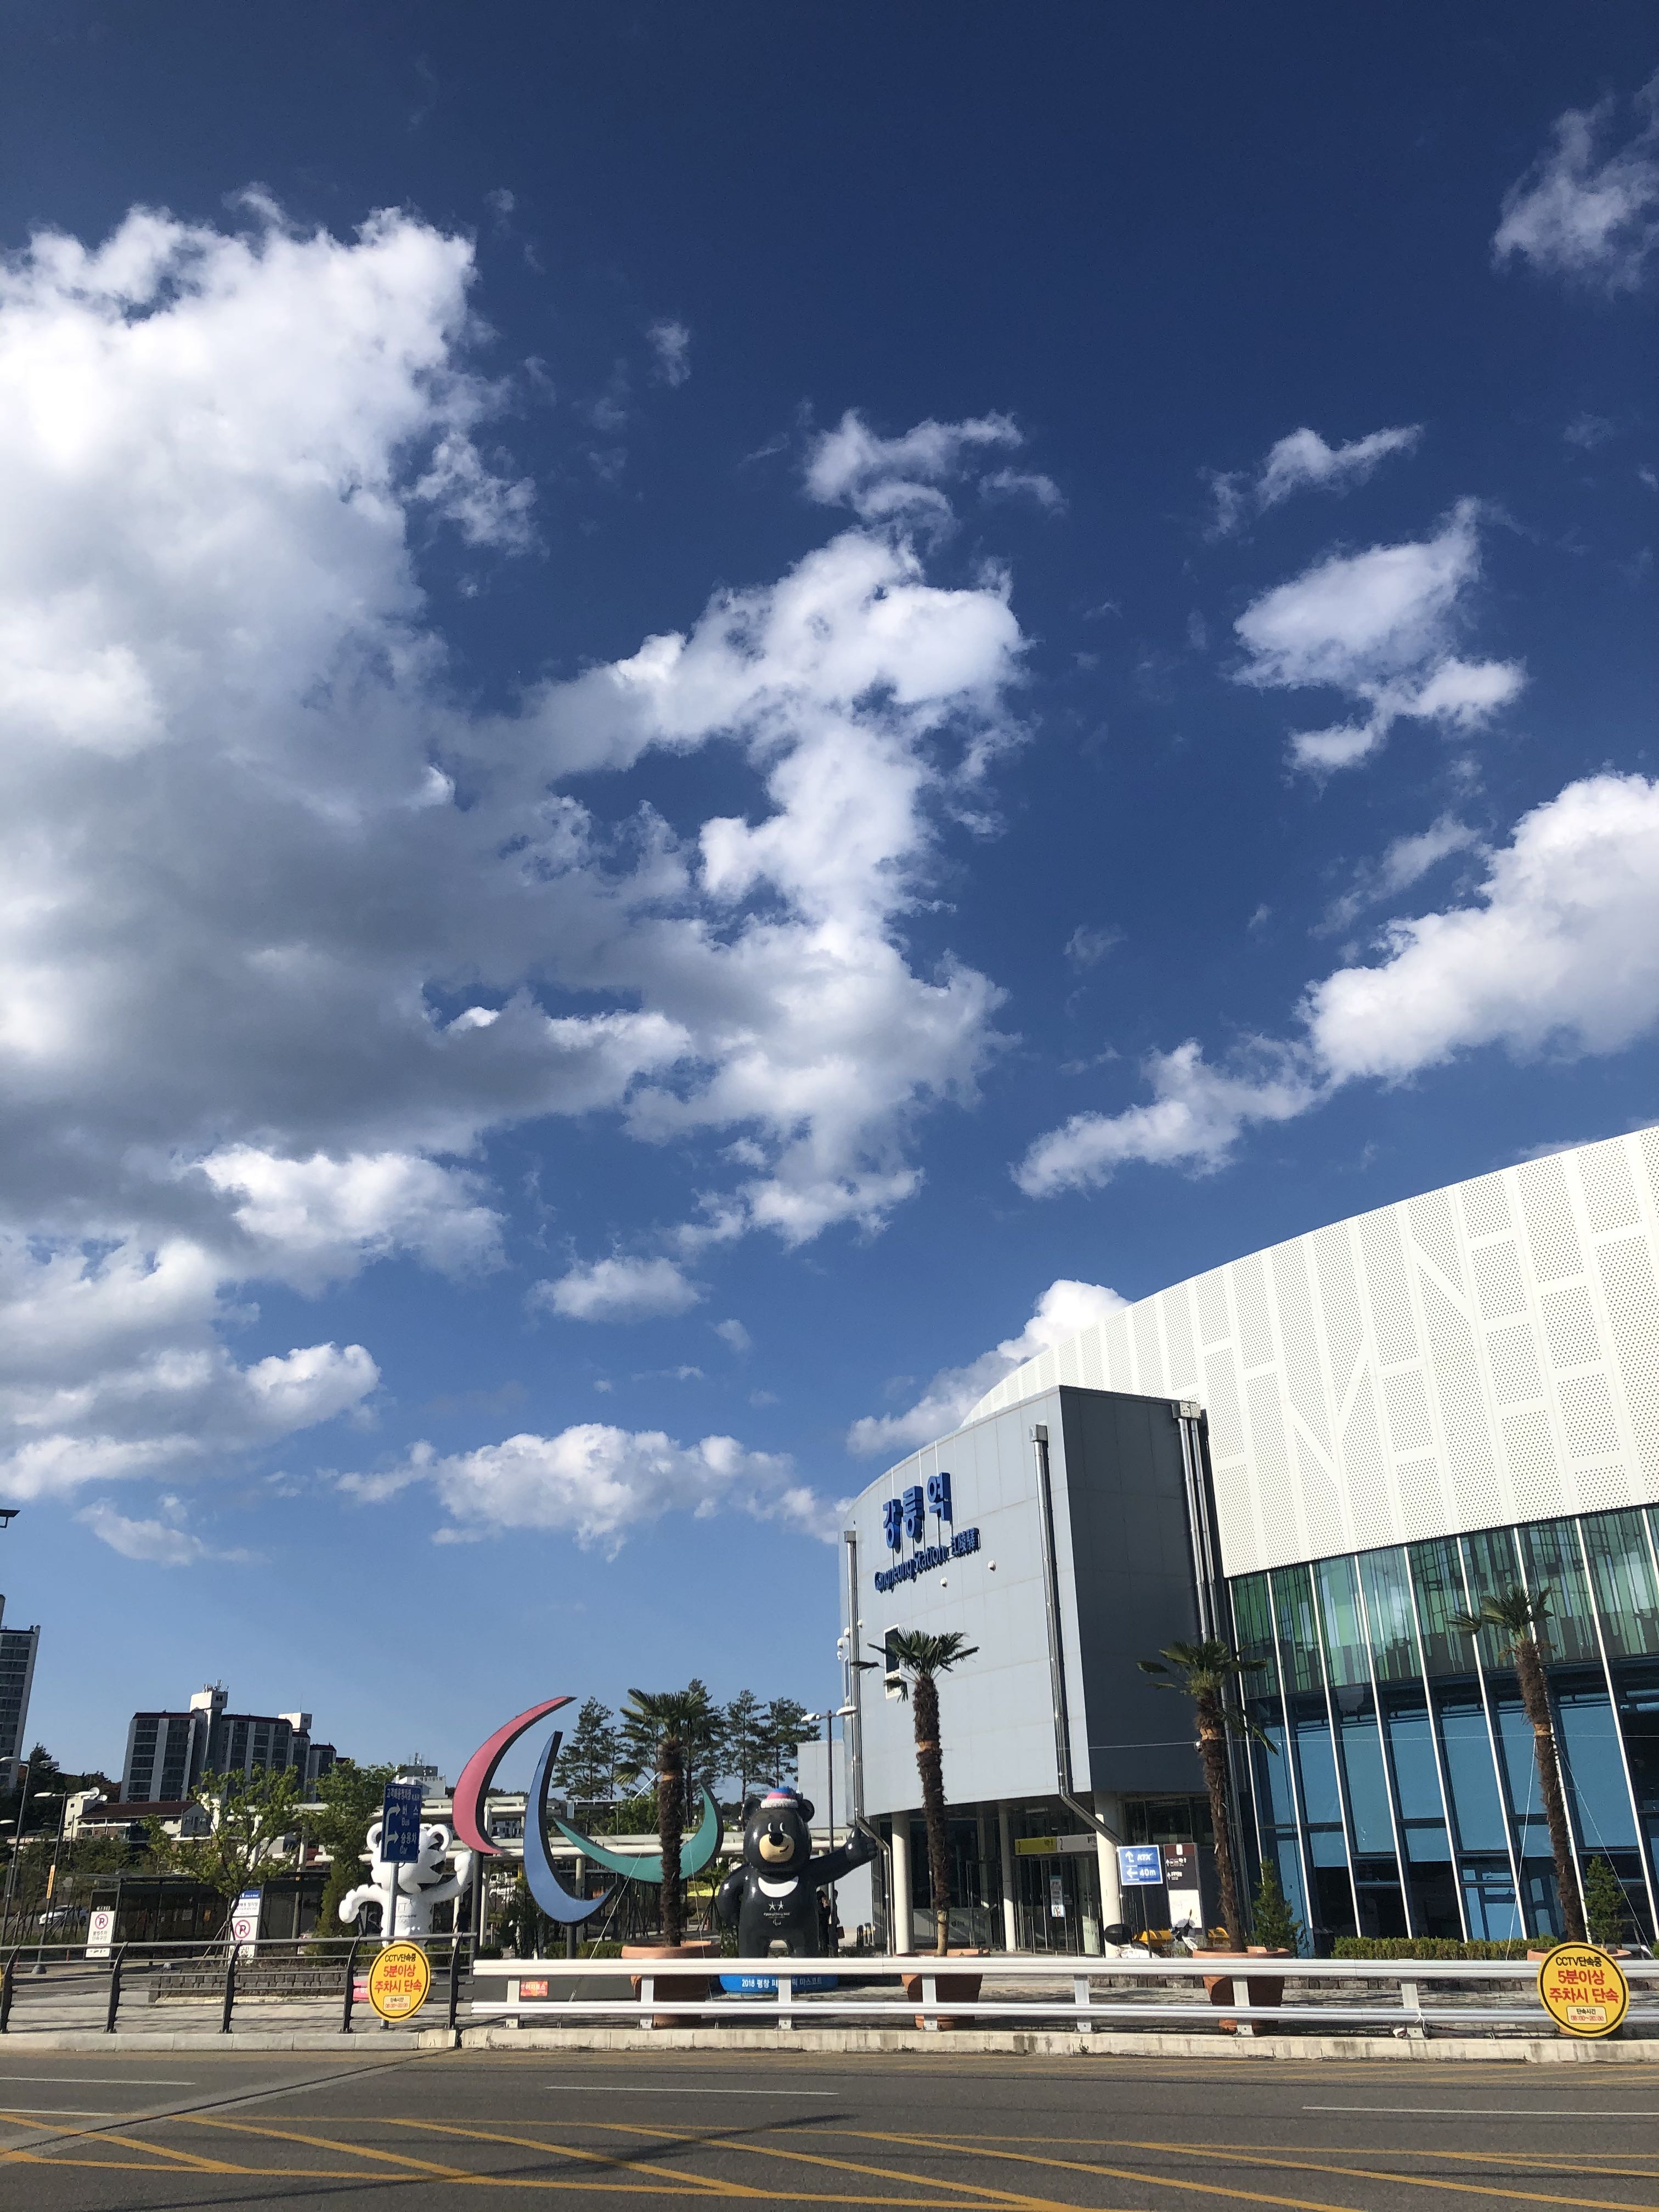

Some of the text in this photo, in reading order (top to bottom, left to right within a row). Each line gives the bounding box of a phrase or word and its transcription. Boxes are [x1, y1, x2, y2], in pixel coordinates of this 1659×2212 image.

[883, 1472, 952, 1551] 강릉역
[875, 1559, 917, 1590] Gangneung
[914, 1545, 949, 1572] Station
[401, 1817, 410, 1826] Bus
[400, 1832, 417, 1844] 승용차
[1137, 1853, 1154, 1861] KTX
[1139, 1868, 1156, 1876] 40m
[385, 1953, 416, 1962] CCTV단속중
[1555, 1956, 1602, 1967] CCTV단속중
[383, 1964, 416, 1978] 5분이상
[742, 1978, 755, 1987] 2018
[757, 1978, 769, 1989] 평창
[1558, 1970, 1605, 1985] 5분이상
[374, 1979, 402, 1994] 주차시
[404, 1979, 422, 1993] 단속
[1549, 1988, 1620, 2004] 주차시 단속
